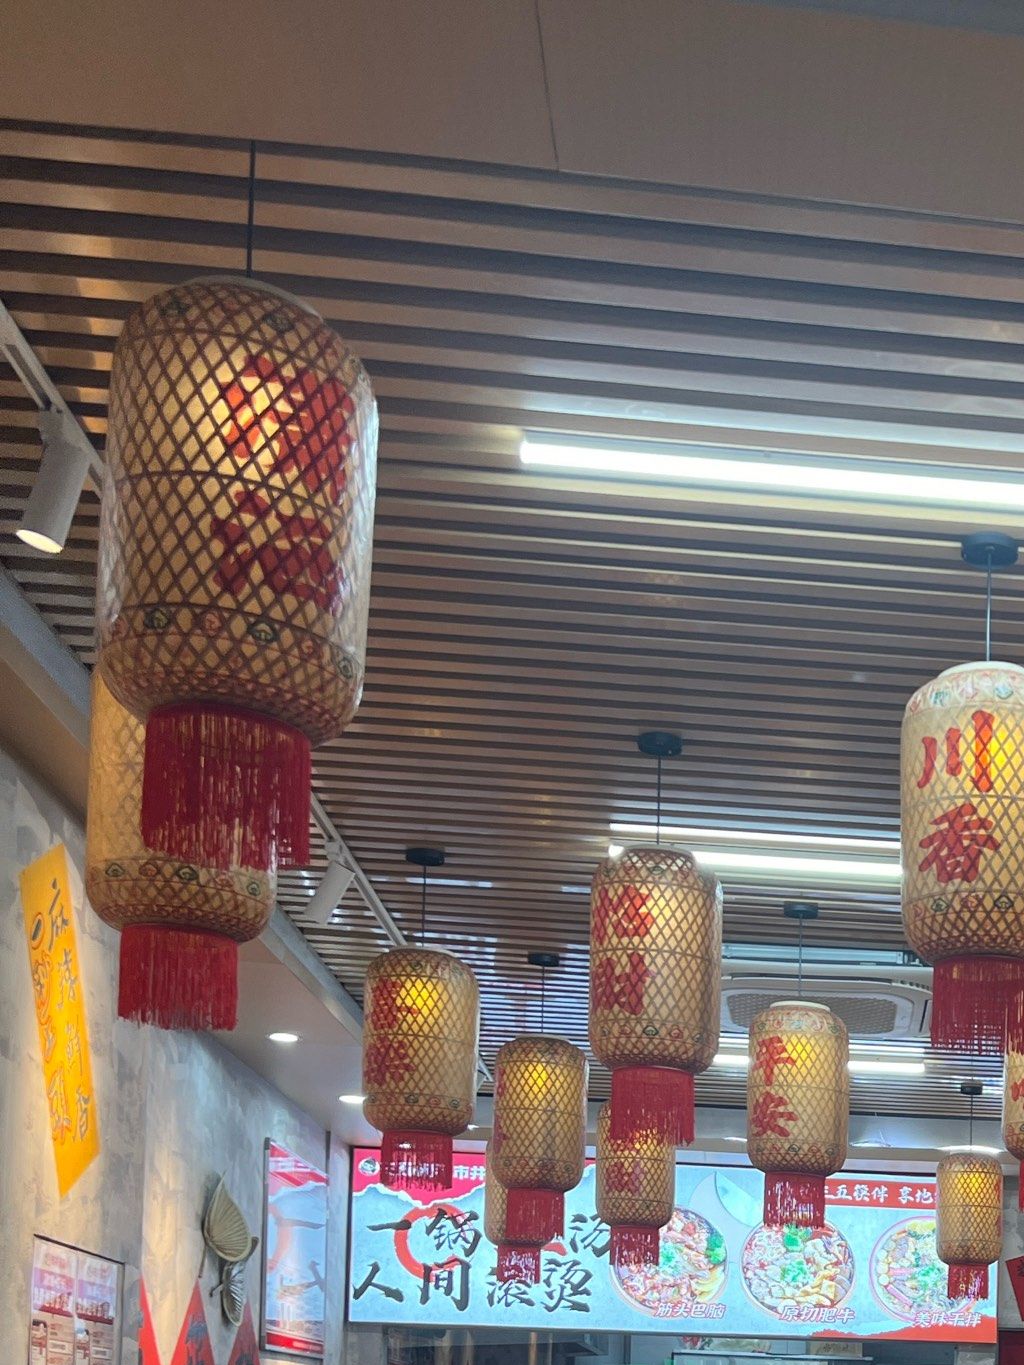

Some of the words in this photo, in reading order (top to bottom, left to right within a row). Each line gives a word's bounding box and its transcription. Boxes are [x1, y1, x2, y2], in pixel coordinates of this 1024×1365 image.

[917, 709, 1000, 884] 川香
[752, 1036, 799, 1137] 平安
[898, 1186, 938, 1205] 享地
[367, 1208, 610, 1258] 一锅汤
[655, 1302, 726, 1319] 筋头巴脑
[781, 1305, 855, 1323] 原切肥牛
